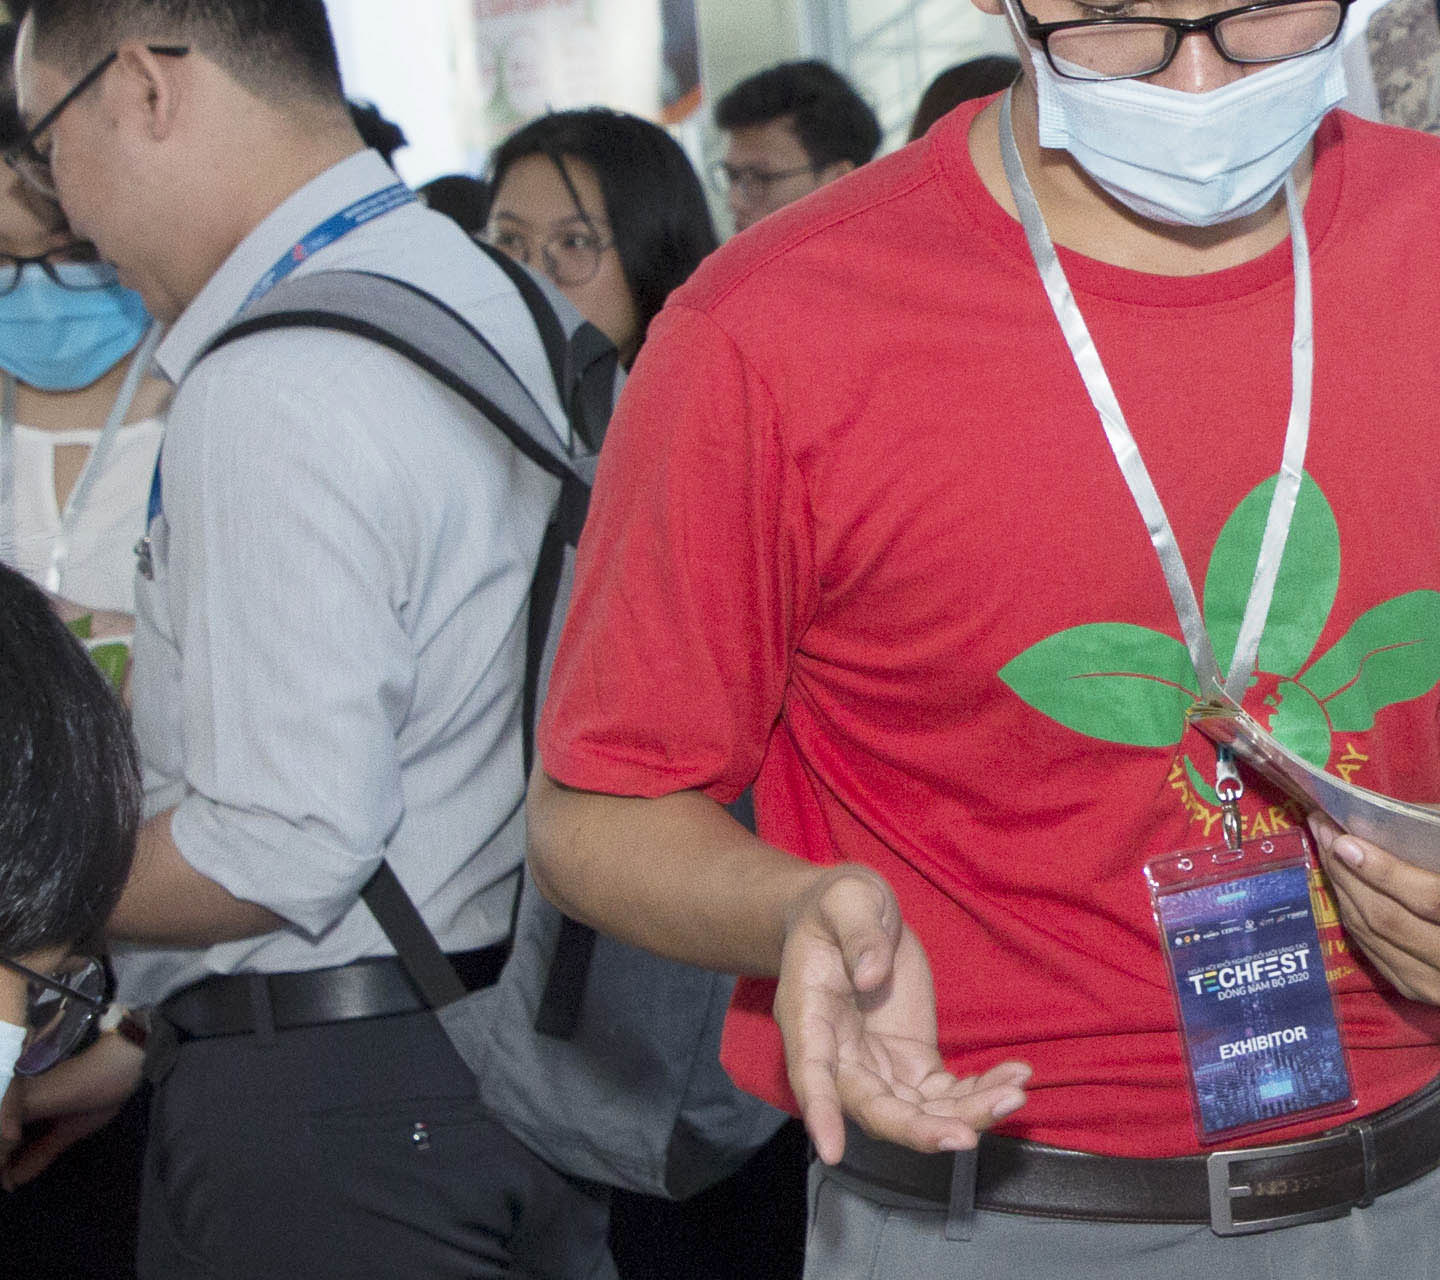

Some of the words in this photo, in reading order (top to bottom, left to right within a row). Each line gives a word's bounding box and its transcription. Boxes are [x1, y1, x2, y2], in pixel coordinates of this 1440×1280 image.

[1188, 949, 1310, 995] TECHFEST
[1287, 971, 1310, 985] 2020
[1219, 1025, 1308, 1060] EXHIBITOR
